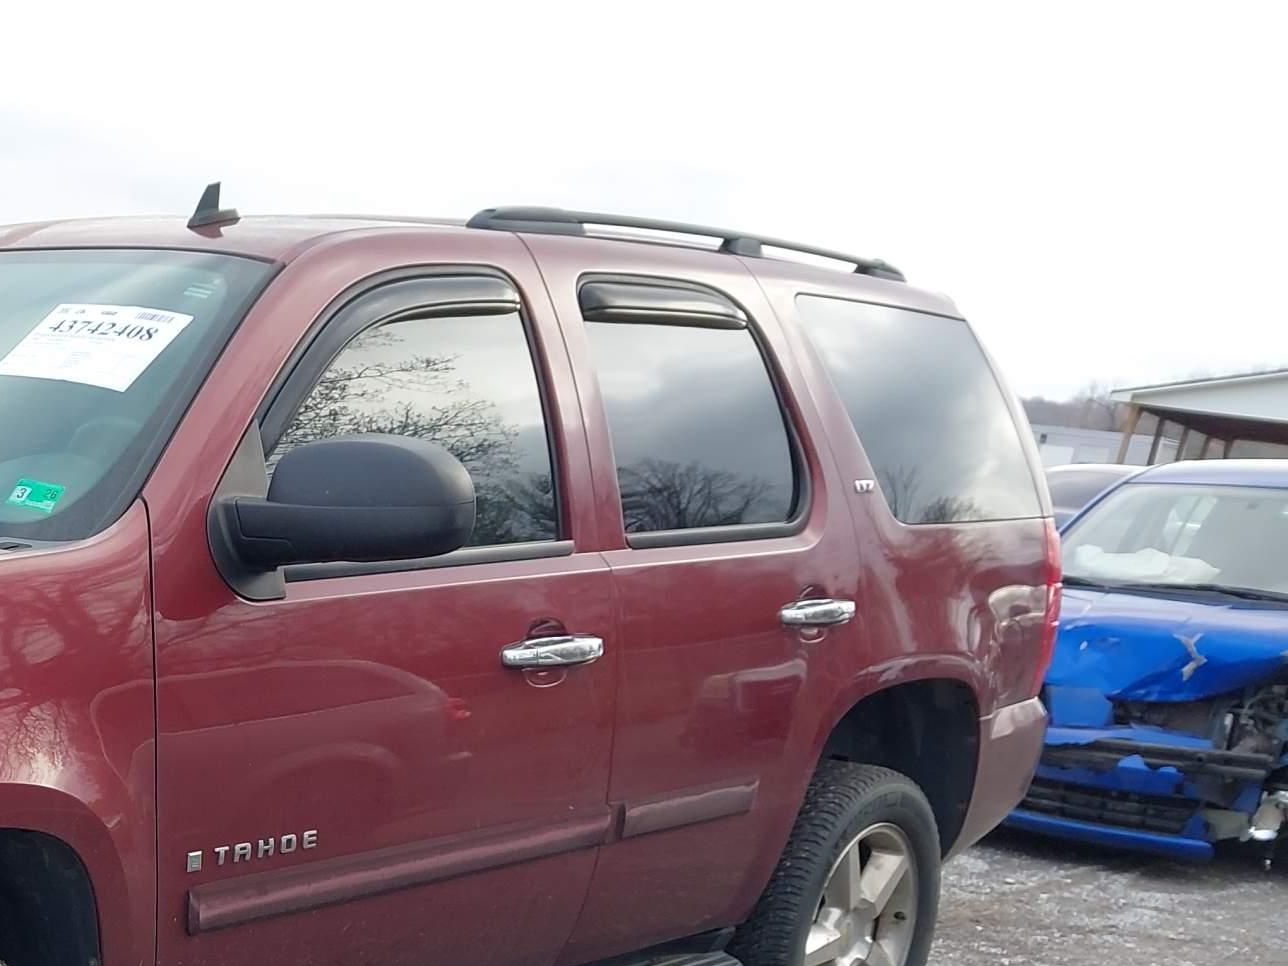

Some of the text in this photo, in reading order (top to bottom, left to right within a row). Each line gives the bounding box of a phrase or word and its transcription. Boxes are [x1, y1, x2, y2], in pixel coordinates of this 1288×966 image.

[47, 319, 159, 341] 43742408
[16, 487, 28, 499] 3
[214, 829, 319, 866] TAHOE
